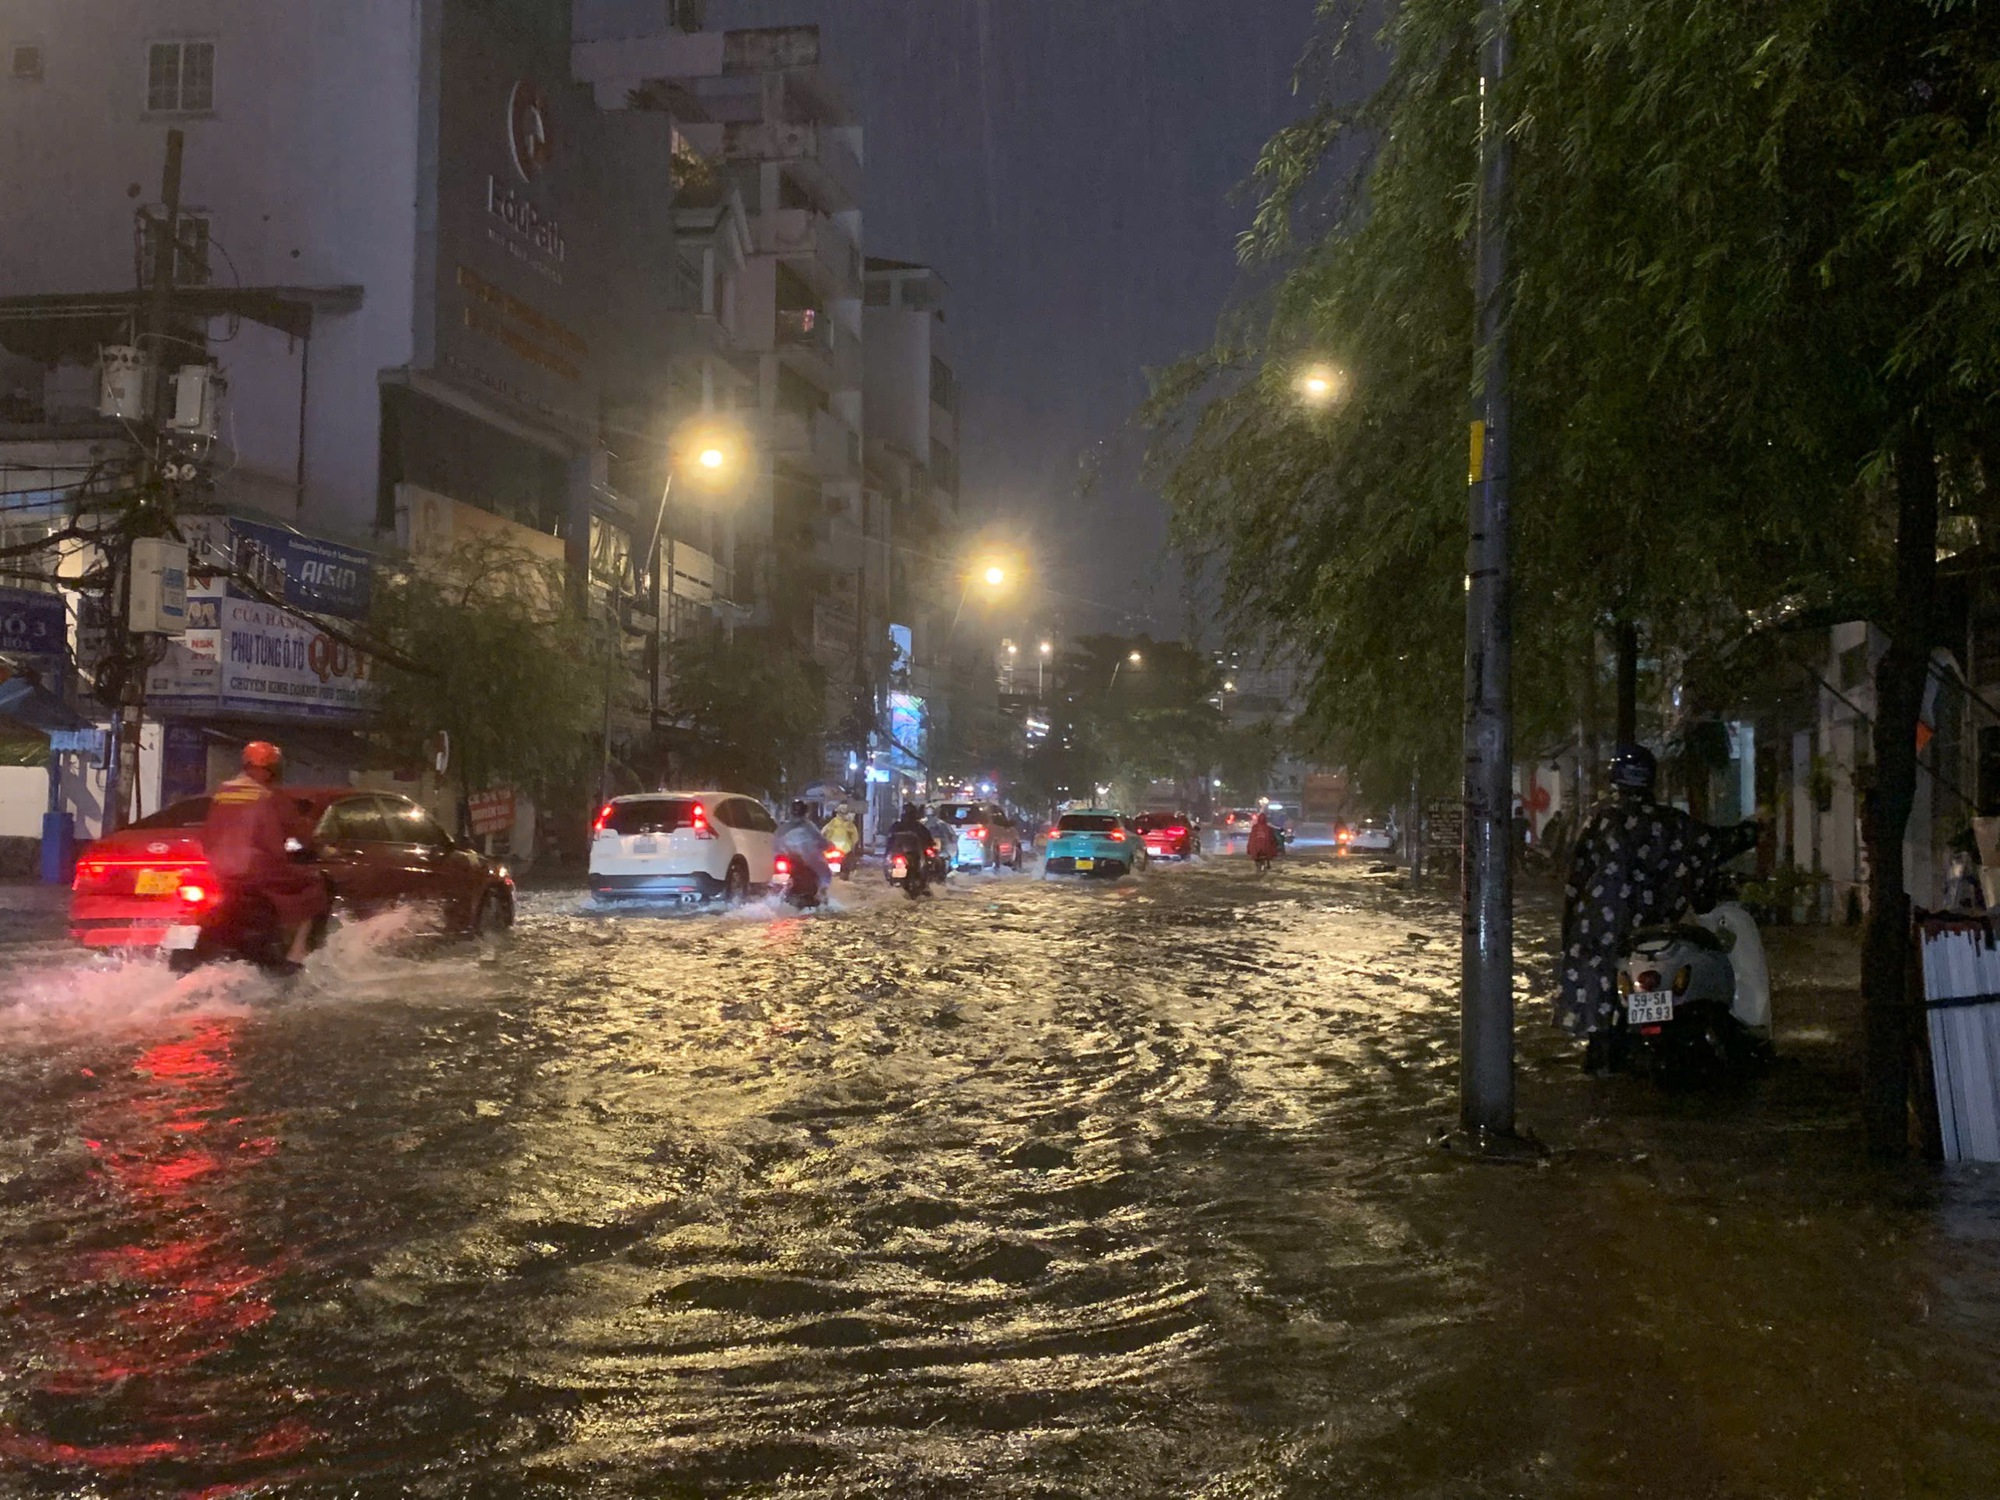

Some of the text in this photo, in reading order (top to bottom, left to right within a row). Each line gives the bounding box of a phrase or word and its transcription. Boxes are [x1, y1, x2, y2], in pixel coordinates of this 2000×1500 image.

[0, 611, 46, 637] Ố 3
[232, 603, 260, 625] CỬA
[191, 639, 215, 649] NSK
[231, 629, 305, 671] PHỤ TÙNG Ô TÔ
[1631, 1006, 1671, 1022] 076.93
